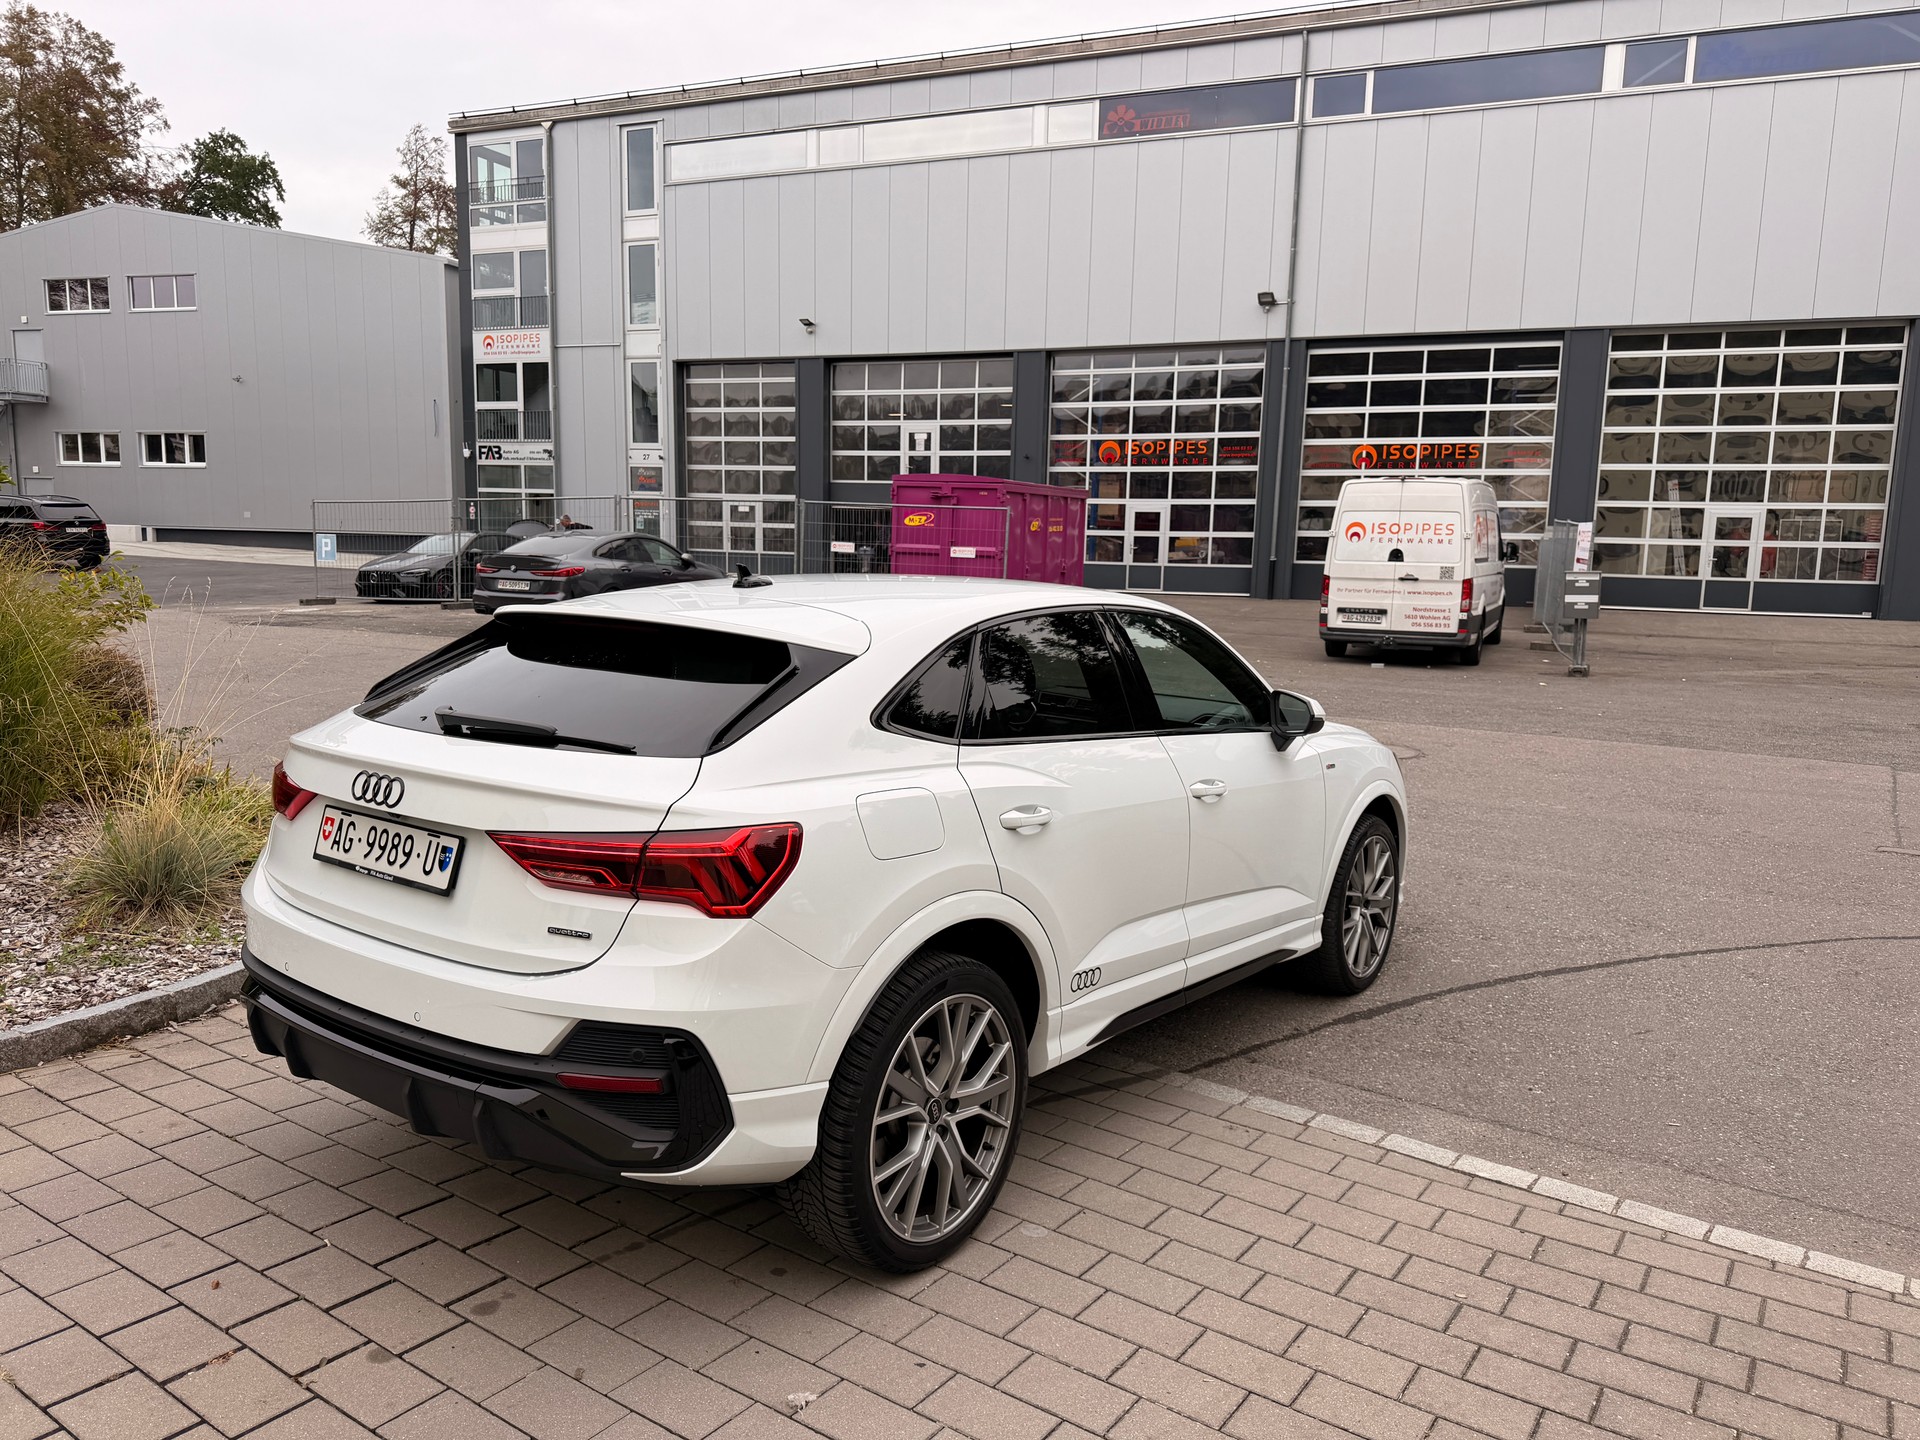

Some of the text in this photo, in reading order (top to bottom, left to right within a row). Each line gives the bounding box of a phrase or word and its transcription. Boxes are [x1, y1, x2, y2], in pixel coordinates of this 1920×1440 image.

[496, 333, 541, 344] ISOPIPES
[478, 445, 503, 460] FAB
[1124, 440, 1208, 455] ISOPIPES
[1382, 444, 1480, 460] ISOPIPES
[1377, 460, 1476, 469] FERNWÄRME
[1371, 522, 1455, 536] ISOPIPES
[1370, 536, 1454, 545] FERNWÄRME
[322, 538, 331, 558] P
[548, 928, 590, 938] quattro
